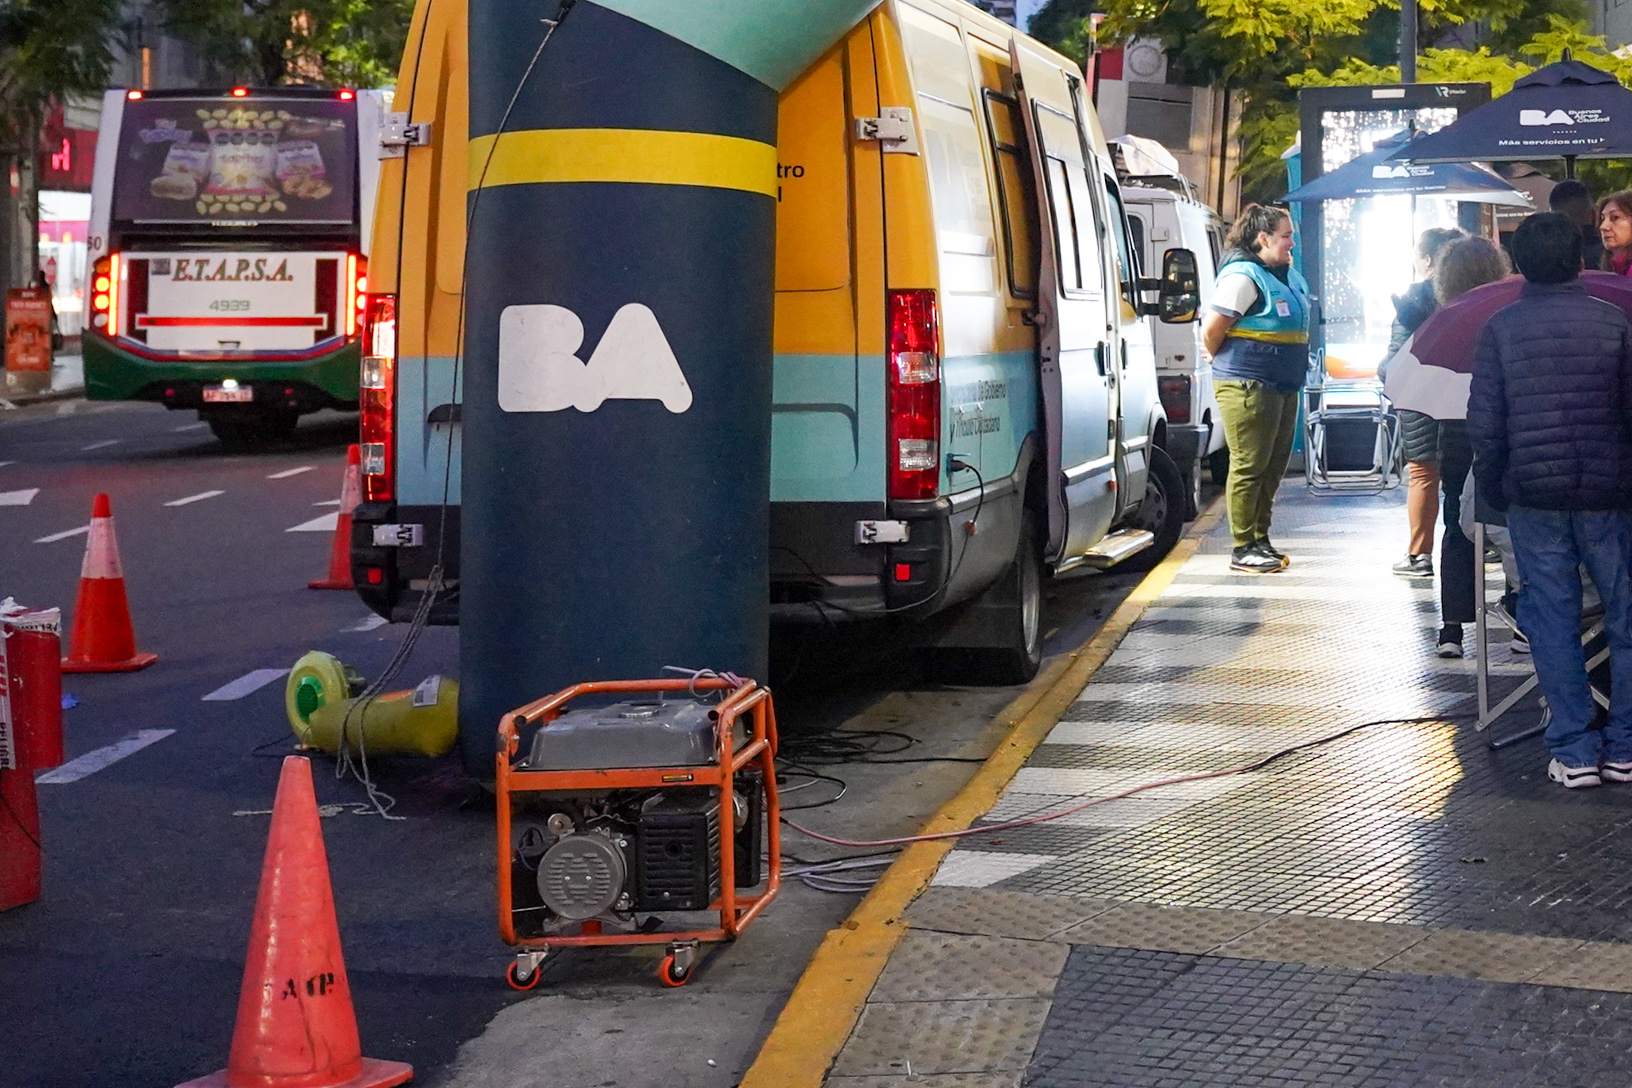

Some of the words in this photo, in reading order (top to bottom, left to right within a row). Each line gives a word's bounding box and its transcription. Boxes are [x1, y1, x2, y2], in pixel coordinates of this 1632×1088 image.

[1520, 109, 1575, 126] BA
[1372, 165, 1411, 179] BA
[172, 258, 294, 281] E.T.A.P.S.A.
[497, 301, 694, 414] BA
